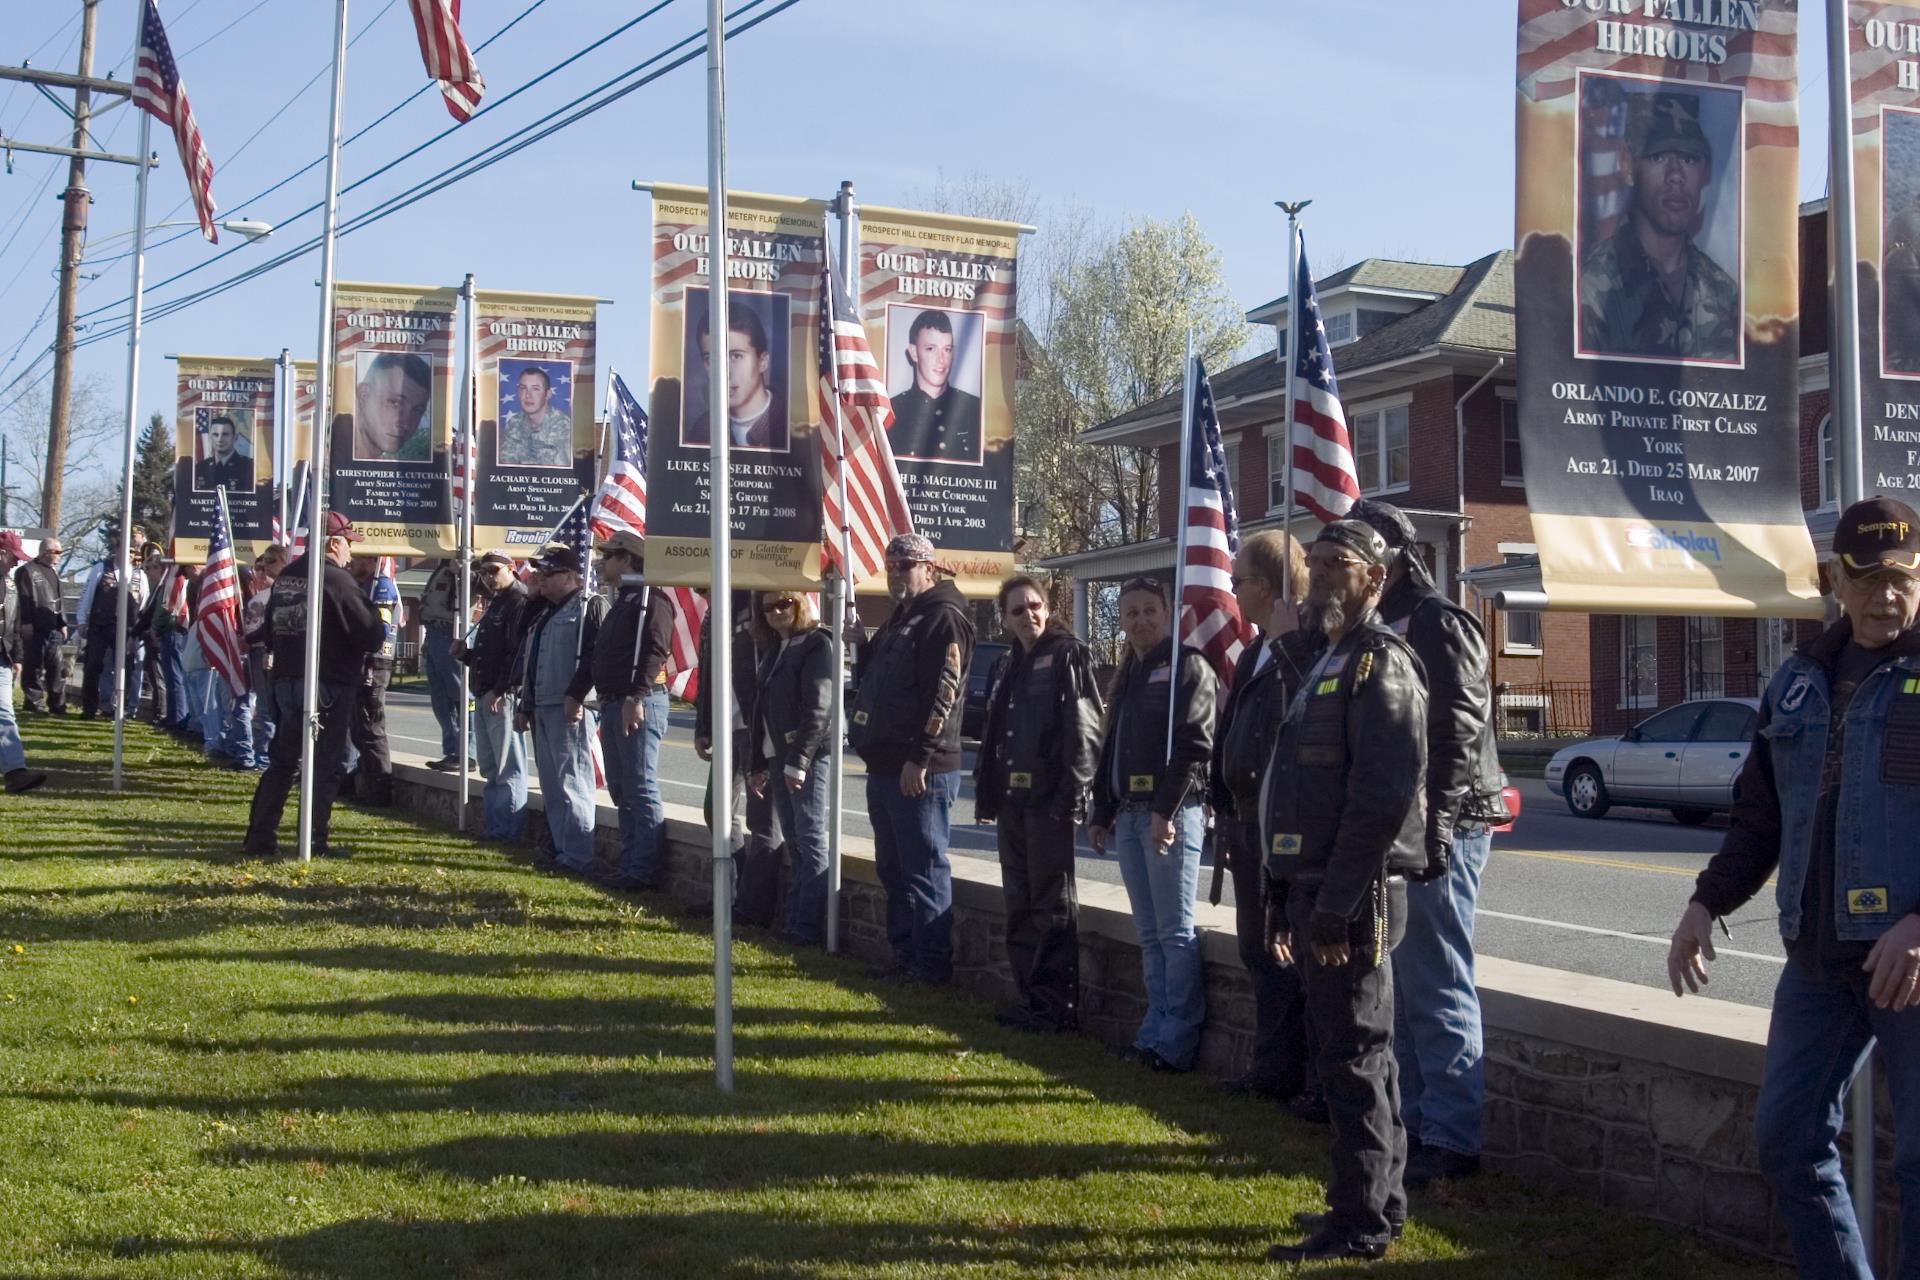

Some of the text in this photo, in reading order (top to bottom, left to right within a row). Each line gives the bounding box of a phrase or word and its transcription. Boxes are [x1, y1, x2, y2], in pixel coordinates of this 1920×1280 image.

[1642, 0, 1759, 31] FALLEN
[1596, 20, 1727, 65] HEROES
[659, 204, 698, 216] PROSPECT
[728, 212, 757, 222] METERY
[760, 215, 779, 225] FLAG
[780, 217, 818, 229] MEMORIAL
[862, 224, 1011, 250] PROSPECT HILL CEMETERY FLAG MEMORIAL
[727, 238, 802, 262] FALLEN
[696, 256, 780, 281] HROES
[876, 252, 997, 282] OUR FALLEN
[898, 275, 975, 300] HEROES
[347, 313, 441, 331] OUR FALLEN
[490, 322, 581, 339] OUR FALLEN
[364, 329, 425, 345] HEROES
[506, 338, 566, 353] HEROES
[188, 379, 263, 392] OUR FALLEN
[201, 391, 250, 402] HEROES
[1551, 382, 1768, 412] ORLANDO E. GONZALEZ
[1885, 403, 1920, 420] DEN
[1563, 408, 1758, 435] ARMY PRIVATE FIRST CLASS
[1873, 425, 1920, 443] MARIN
[1642, 436, 1684, 455] YORK
[336, 469, 395, 479] CHRISTOPHER
[405, 471, 450, 480] CUTCHALL
[667, 460, 802, 477] LUKE SSER RUNYAN
[1566, 456, 1760, 483] AGE 21, DIED 25 MAR 2007
[490, 474, 579, 485] ZACHARY R. CLOUSER
[910, 475, 920, 485] B.
[923, 475, 982, 490] MAGLIONE
[984, 479, 997, 490] III
[1876, 472, 1904, 489] AGE
[365, 498, 376, 507] 31,
[396, 499, 404, 507] 29
[421, 500, 437, 508] 2003
[735, 491, 768, 503] GROVE
[912, 487, 940, 500] LANCE
[942, 489, 987, 503] CORPORAL
[1649, 485, 1684, 505] IRAQ
[508, 503, 519, 512] 19,
[695, 503, 710, 516] 21,
[738, 505, 750, 516] 17
[773, 507, 796, 517] 2008
[941, 503, 966, 514] YORK
[729, 521, 746, 531] RAQ
[914, 514, 986, 529] DIED 1 APR 2003
[366, 527, 423, 538] CONEWAGO
[425, 529, 440, 538] INN
[505, 530, 551, 544] Revolut
[1857, 521, 1898, 540] Semper
[665, 545, 744, 560] ASSOCIA OF
